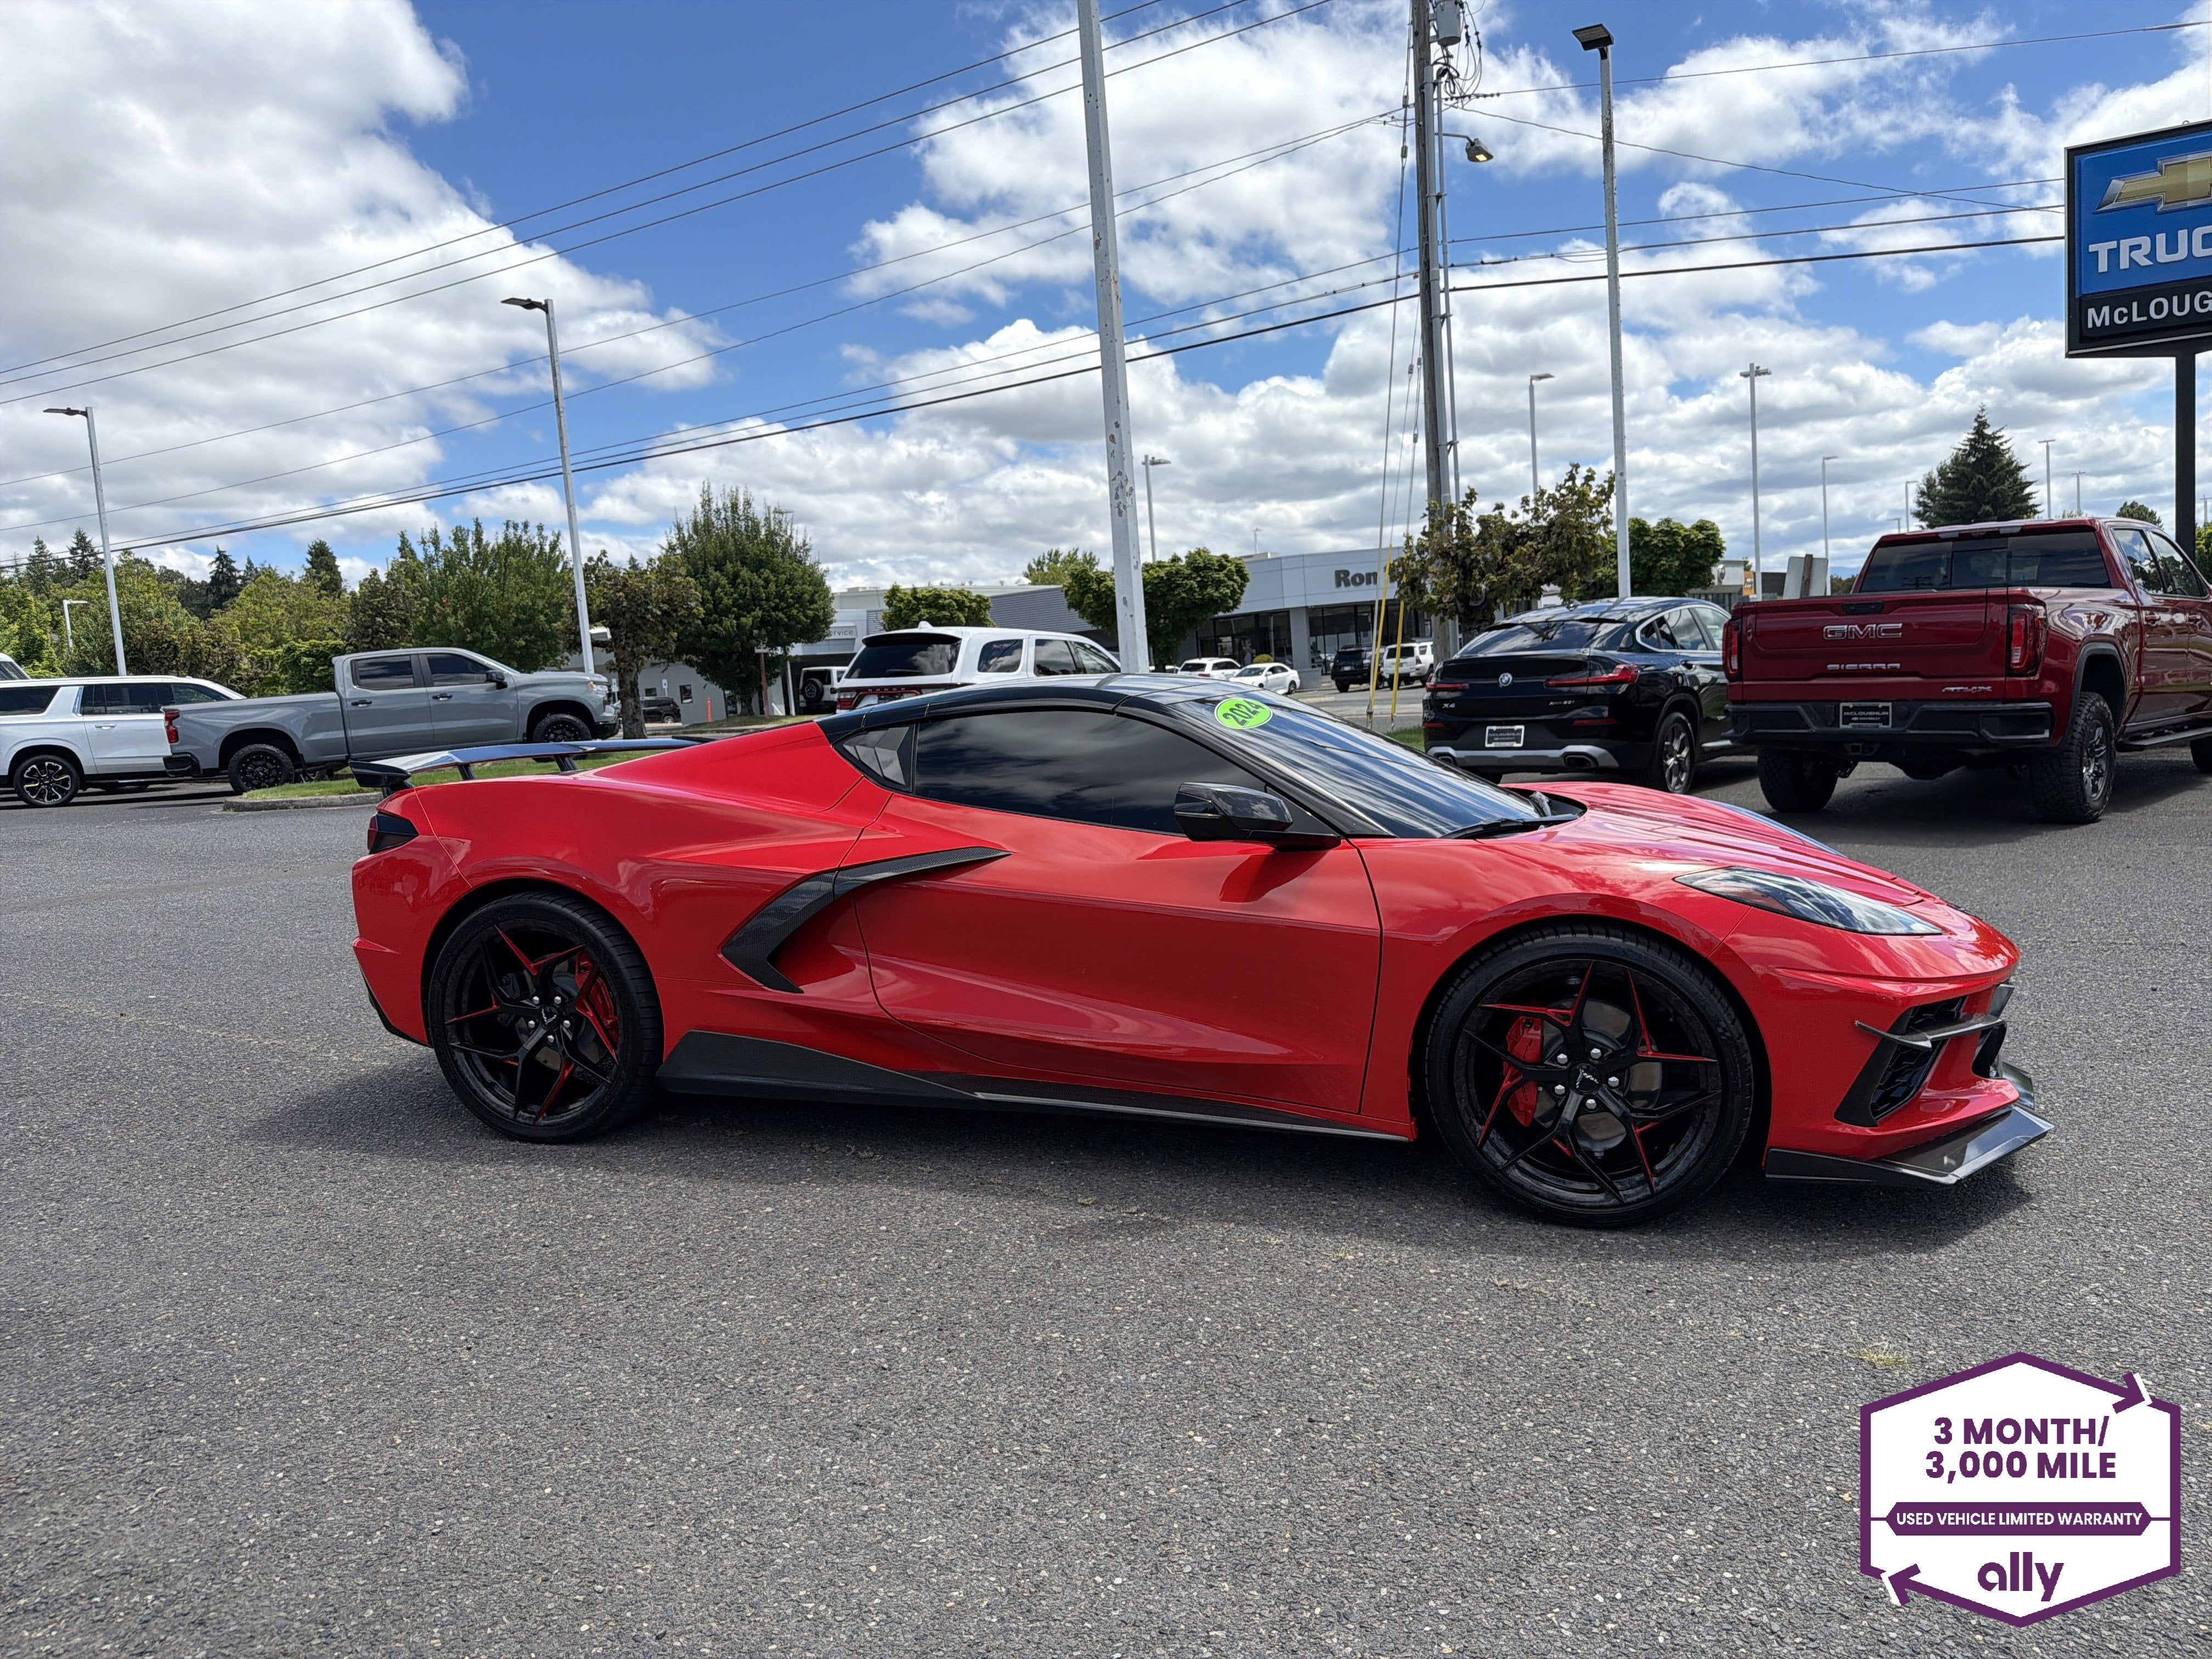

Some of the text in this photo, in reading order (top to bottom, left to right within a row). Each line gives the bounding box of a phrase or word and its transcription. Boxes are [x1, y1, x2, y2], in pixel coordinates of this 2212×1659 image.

[2088, 225, 2212, 274] TRUC
[1335, 569, 1378, 588] Ron
[1823, 623, 1903, 640] GMC
[1222, 699, 1267, 727] 2024
